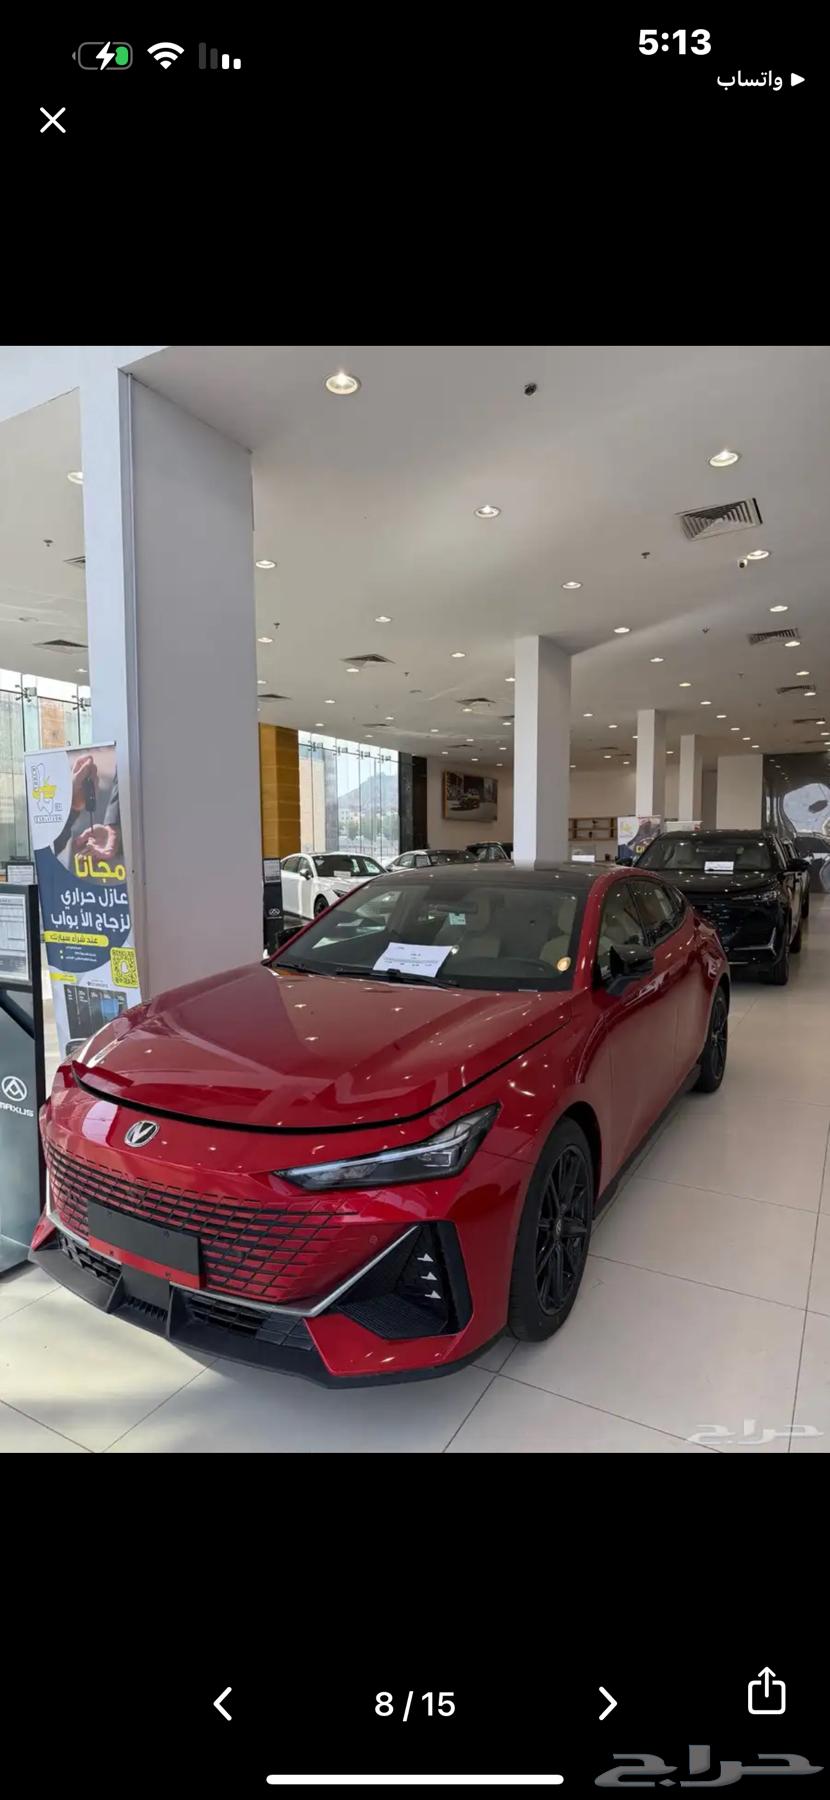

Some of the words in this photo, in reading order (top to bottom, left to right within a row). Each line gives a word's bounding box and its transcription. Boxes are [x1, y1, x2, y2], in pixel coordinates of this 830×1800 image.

[61, 887, 96, 910] حراري
[98, 888, 128, 907] عازل
[95, 912, 131, 932] لزجاج
